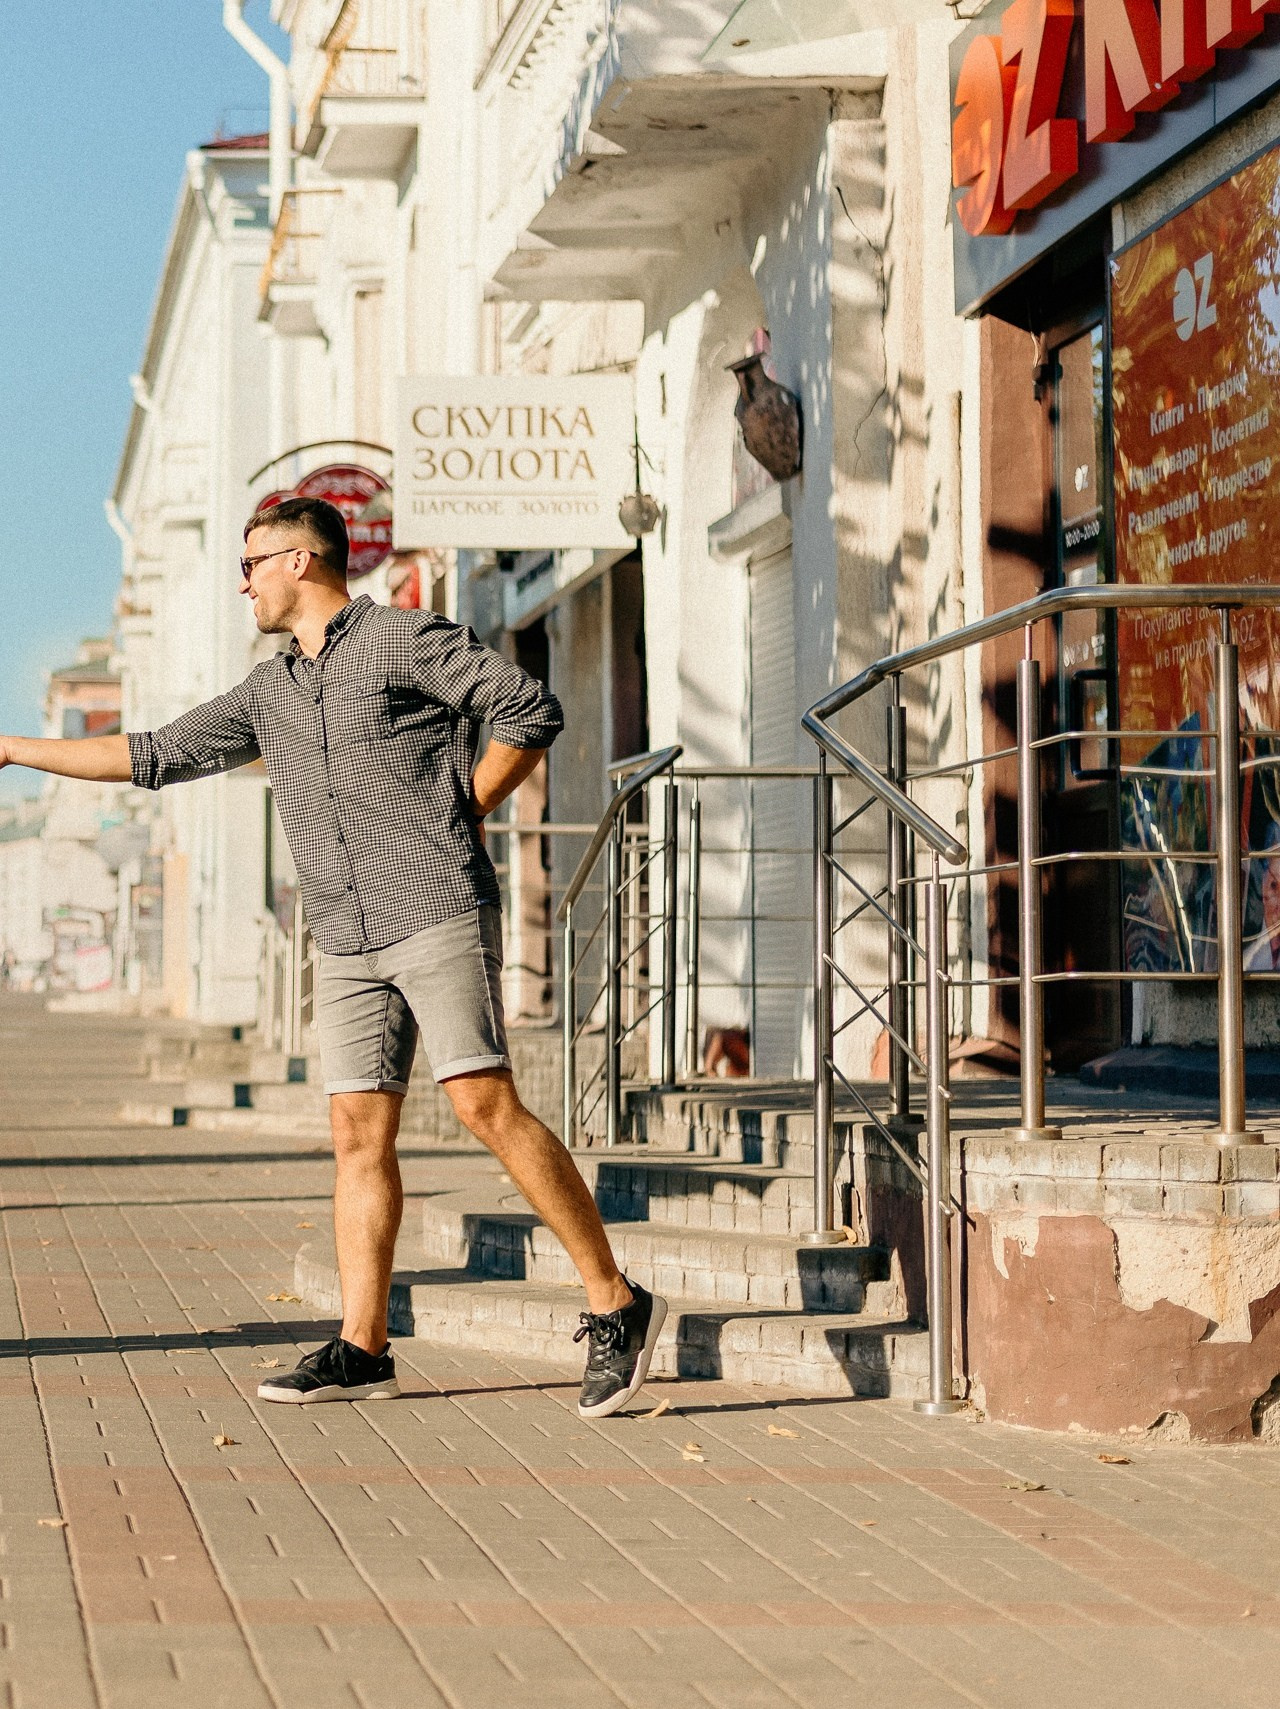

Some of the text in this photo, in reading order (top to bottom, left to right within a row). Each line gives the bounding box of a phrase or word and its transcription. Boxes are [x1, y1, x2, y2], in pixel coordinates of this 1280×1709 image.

[412, 404, 596, 439] СКУПКА
[1150, 403, 1185, 437] Книги
[1211, 406, 1270, 455] Косметика
[412, 448, 596, 481] ЗОЛОТА
[412, 500, 600, 516] ЦАРСКОЕ ЗОЛОТО
[1128, 455, 1272, 538] Развлечения Творчество
[1167, 535, 1207, 567] многое
[1208, 518, 1248, 556] другое
[1240, 613, 1256, 644] OZ
